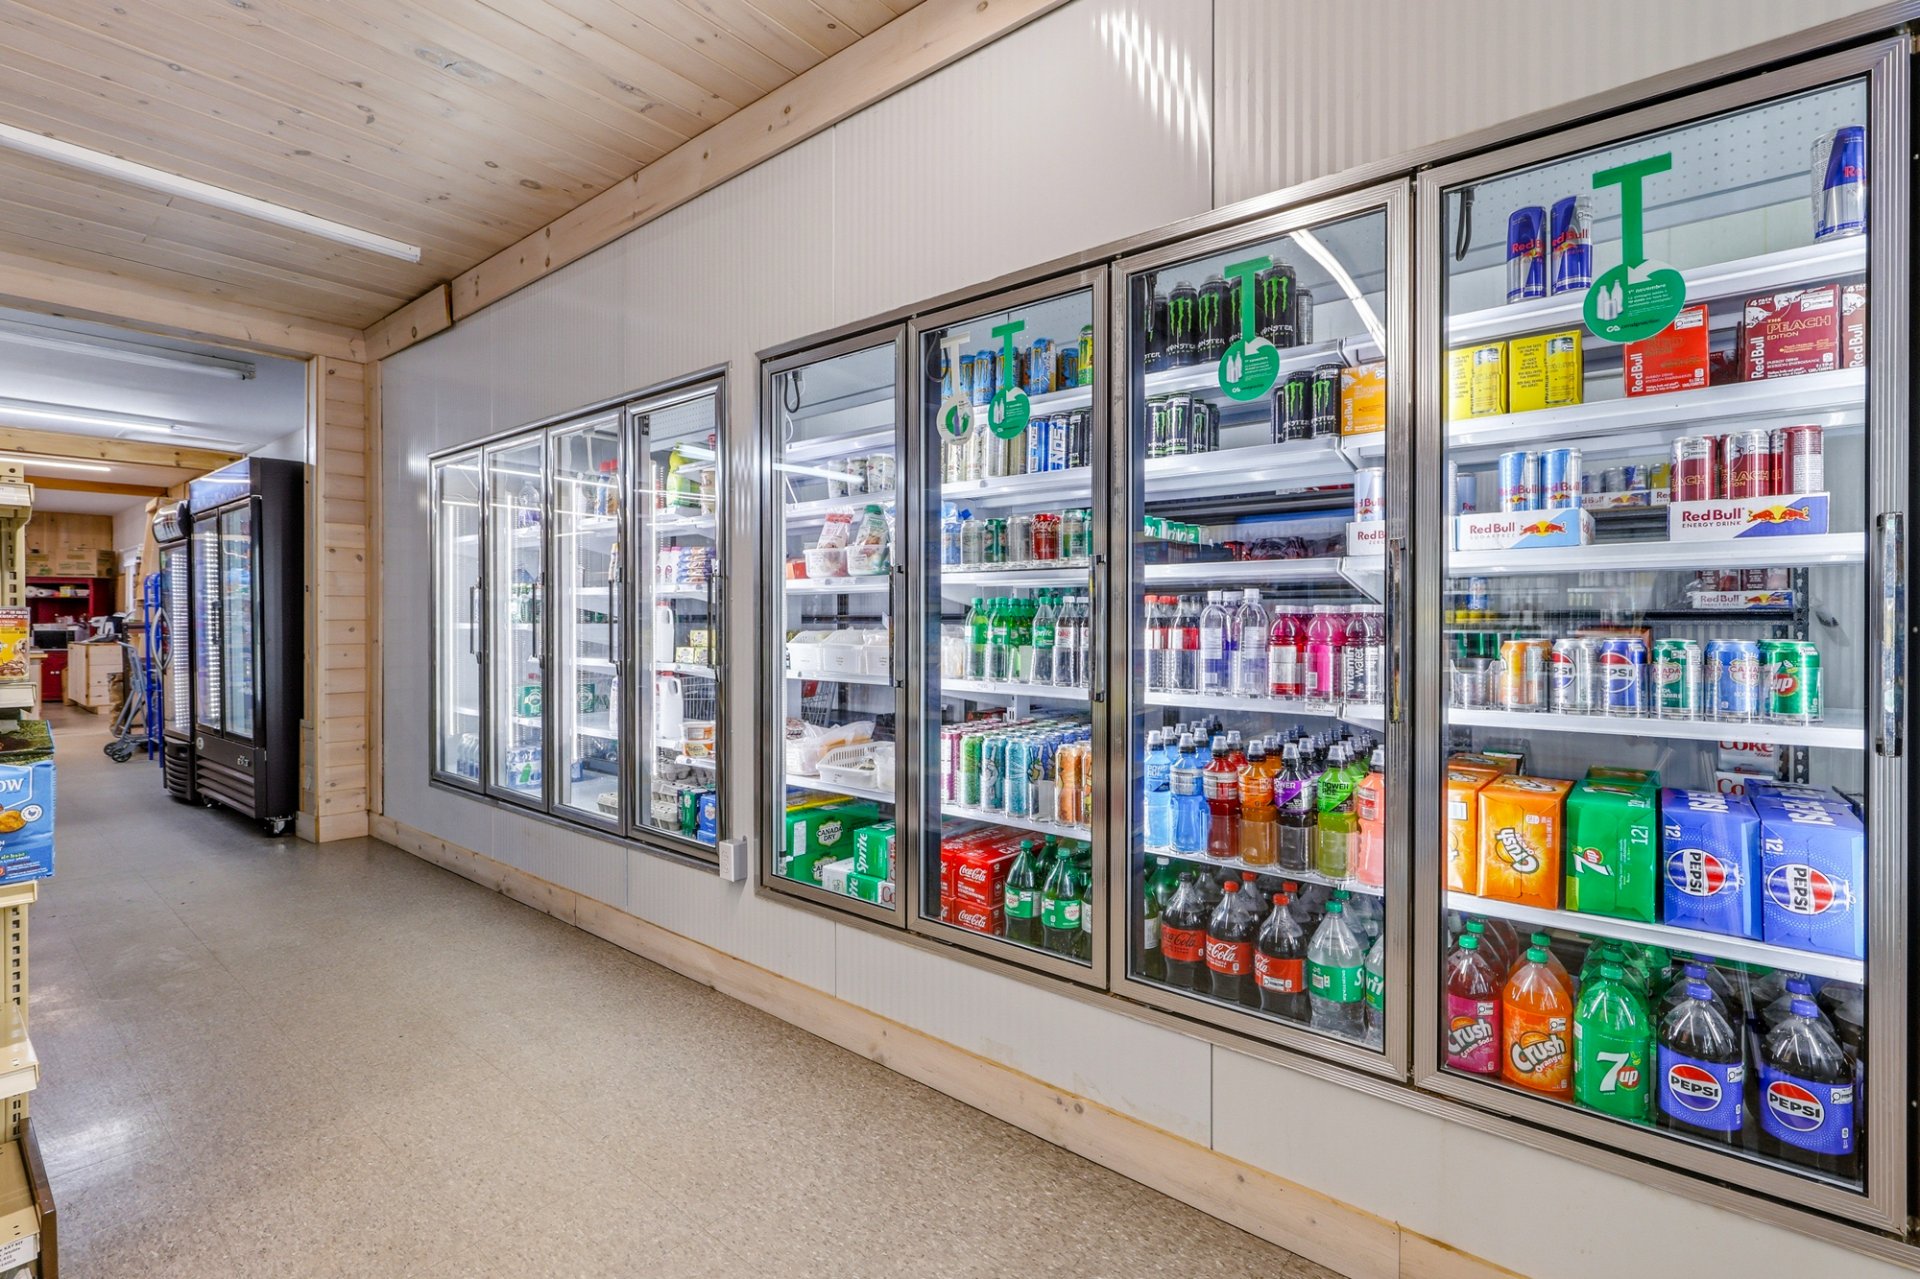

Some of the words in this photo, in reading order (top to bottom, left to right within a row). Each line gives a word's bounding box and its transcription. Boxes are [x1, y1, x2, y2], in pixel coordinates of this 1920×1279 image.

[1844, 165, 1865, 178] Re
[1766, 314, 1832, 335] PEACH
[1767, 331, 1799, 341] EDITION
[1847, 323, 1863, 349] Bull
[1750, 336, 1764, 358] Bull
[1630, 352, 1643, 373] Bull
[1750, 358, 1764, 379] Red
[1631, 372, 1643, 393] Red
[1682, 509, 1711, 522] Red
[1712, 508, 1741, 521] Bull
[1682, 521, 1714, 529] ENERGY
[1357, 530, 1377, 541] Red
[1469, 523, 1492, 535] Red
[1493, 521, 1516, 533] Bull
[1700, 595, 1720, 603] Red
[1719, 594, 1740, 603] Bull
[1346, 647, 1355, 691] vitamin
[1355, 647, 1364, 677] water
[1717, 778, 1745, 796] Co
[817, 826, 843, 837] CANADA
[856, 833, 869, 873] Sprite
[1494, 827, 1539, 874] Crush
[959, 864, 988, 882] Coca-Cola
[1689, 851, 1702, 893] PEPSI
[1793, 866, 1808, 912] PEPSI
[958, 909, 987, 928] Coca-Cola
[1448, 1018, 1493, 1054] Crush
[1511, 1034, 1566, 1072] Crush
[1670, 1075, 1719, 1098] PEPSI
[1769, 1092, 1821, 1119] PEPSI
